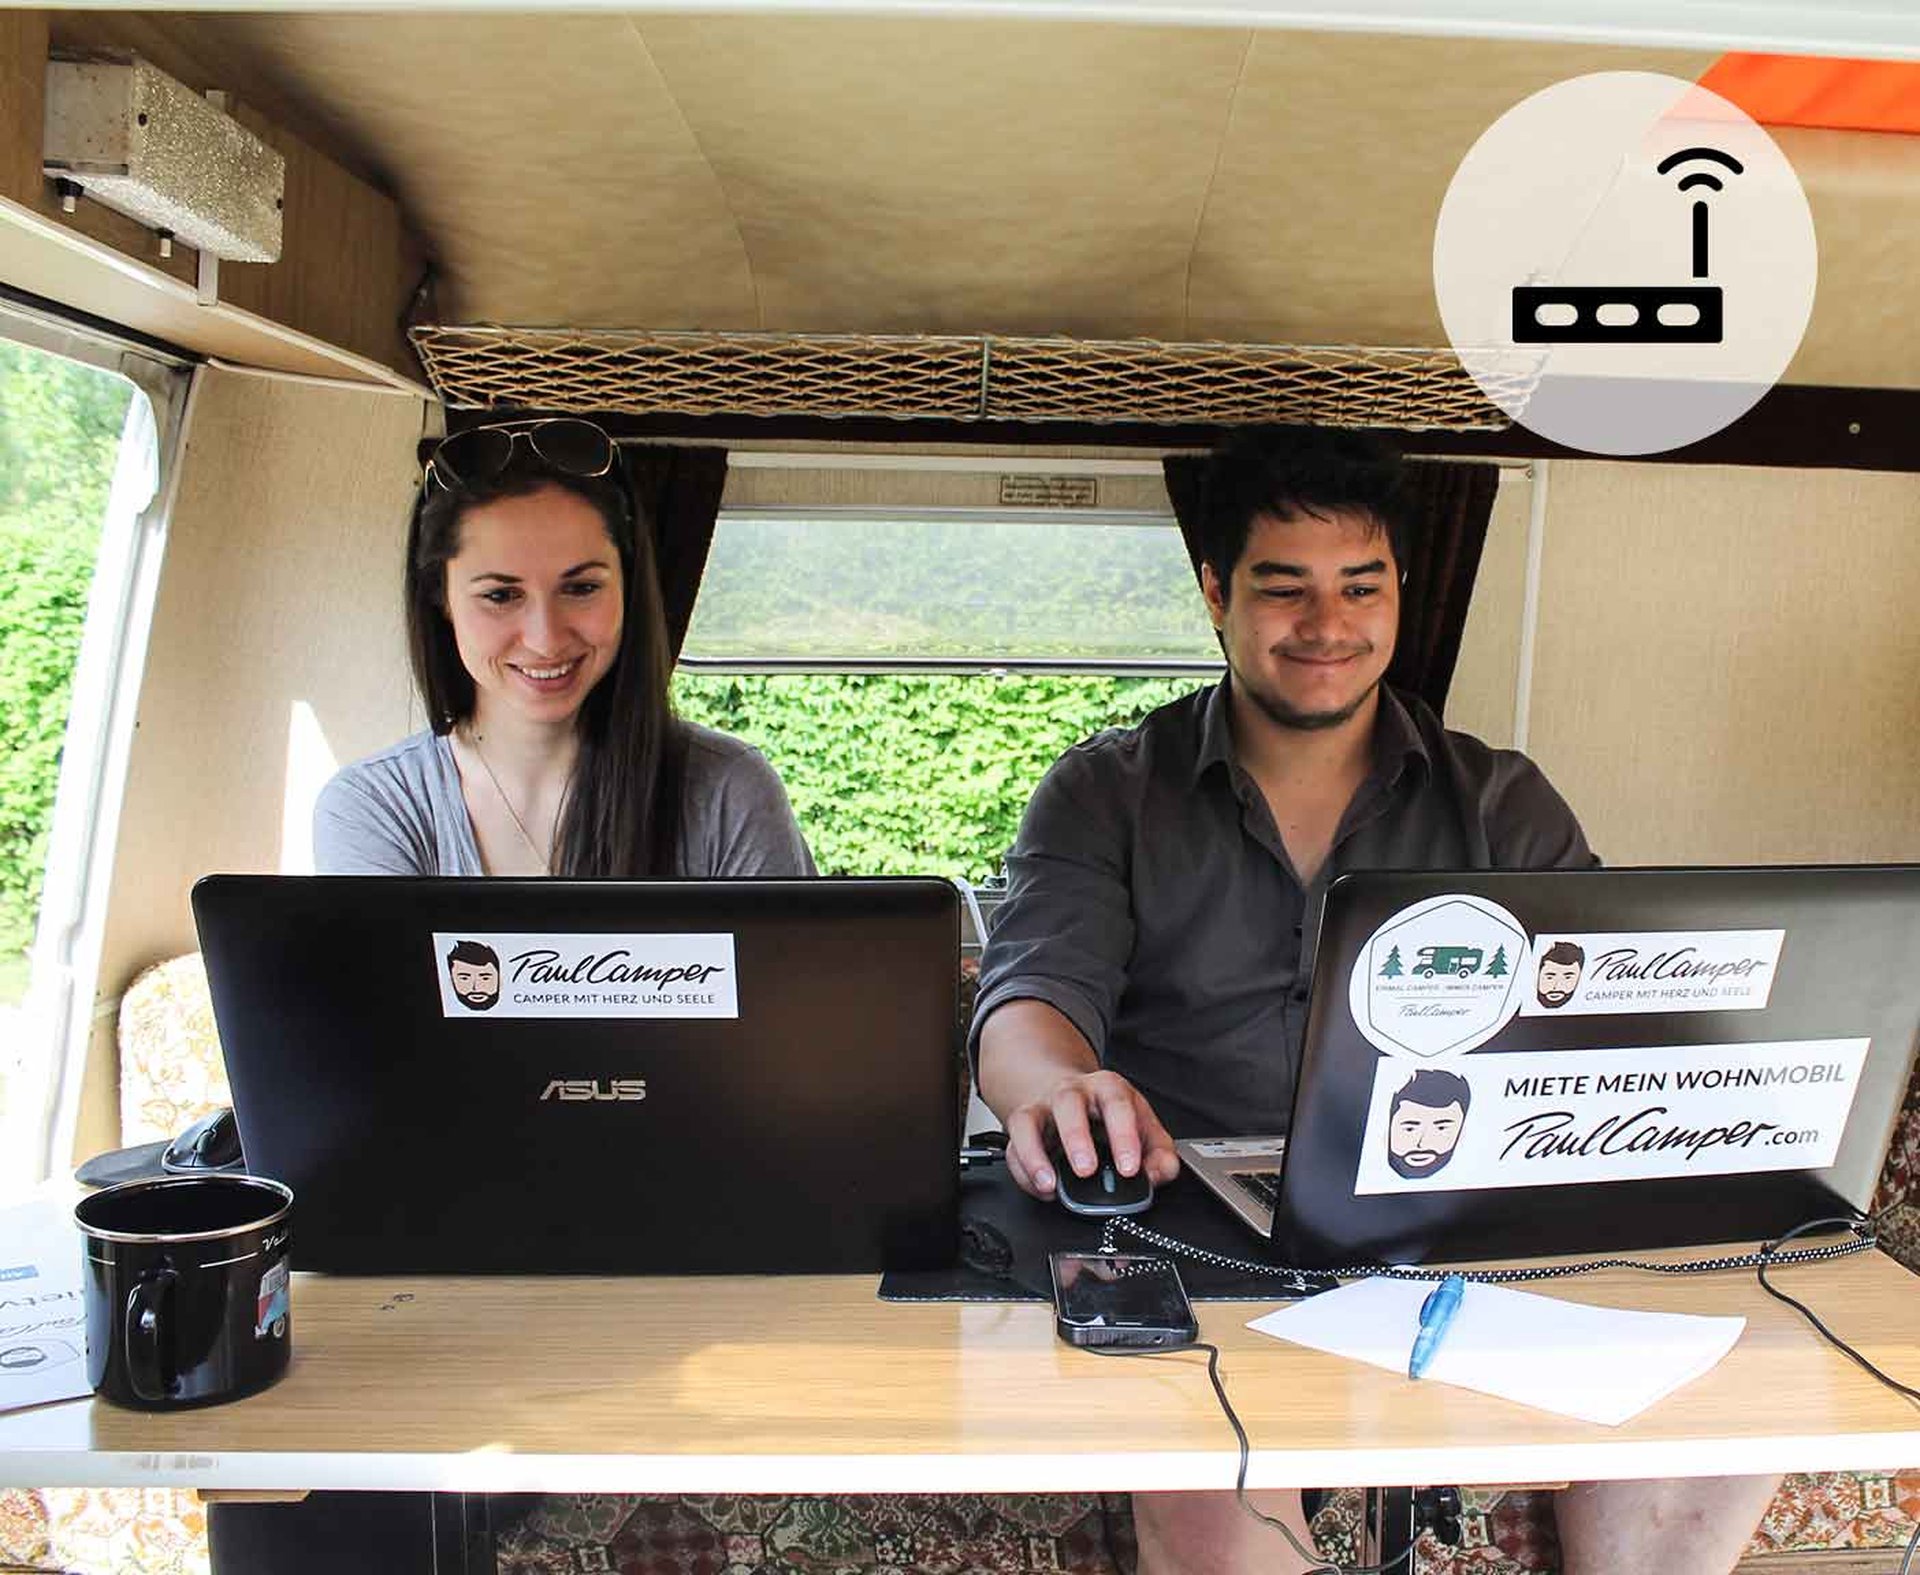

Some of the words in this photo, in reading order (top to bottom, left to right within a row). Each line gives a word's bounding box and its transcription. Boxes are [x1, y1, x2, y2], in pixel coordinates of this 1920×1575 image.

[509, 949, 725, 991] PaulCamper
[1590, 947, 1768, 985] PaulCamper
[513, 993, 570, 1005] CAMPER
[574, 993, 598, 1005] MIT
[602, 993, 638, 1005] HERZ
[642, 993, 672, 1005] UND
[676, 993, 716, 1005] SEELE
[1585, 990, 1634, 1002] CAMPER
[1636, 989, 1658, 1000] MIT
[1660, 988, 1690, 999] HERZ
[1692, 987, 1718, 998] UND
[539, 1079, 647, 1102] ASUS
[1504, 1074, 1588, 1098] MIETE
[1596, 1070, 1666, 1095] MEIN
[1675, 1062, 1846, 1091] WOHNMOBIL
